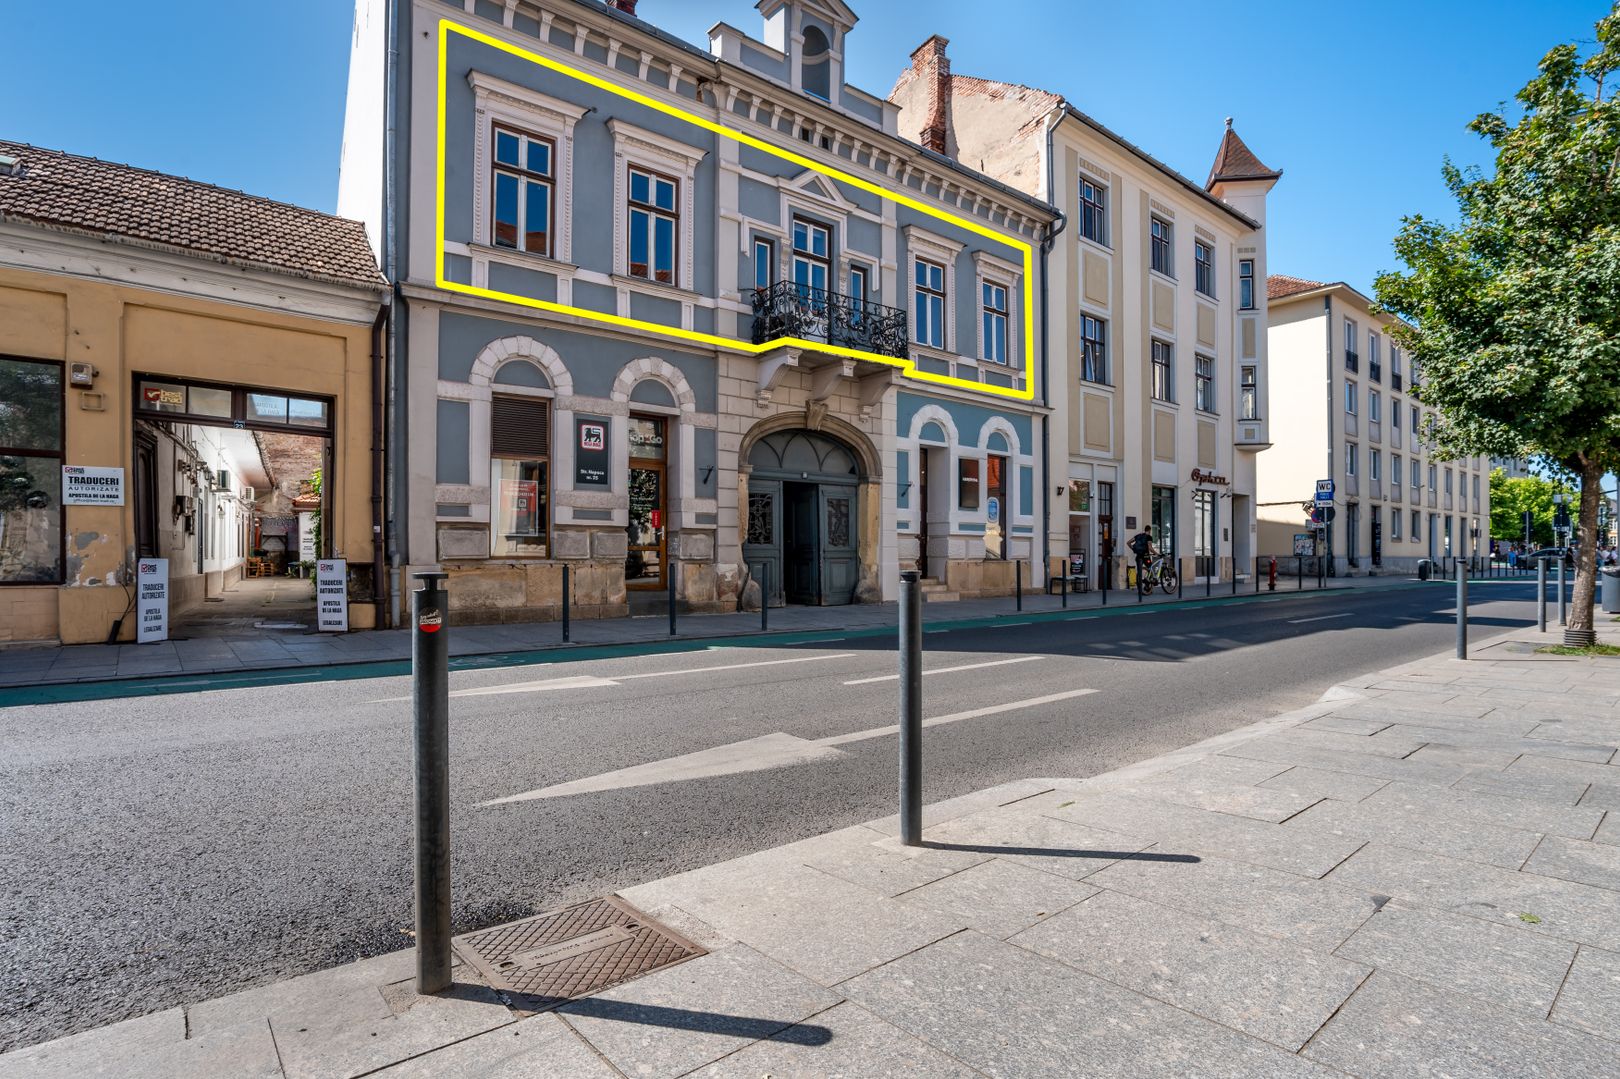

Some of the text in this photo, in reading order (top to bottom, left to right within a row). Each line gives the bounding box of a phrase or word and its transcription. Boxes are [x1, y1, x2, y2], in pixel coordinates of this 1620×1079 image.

[160, 390, 182, 398] best
[160, 396, 182, 404] trad
[68, 476, 119, 485] TRADUCERI
